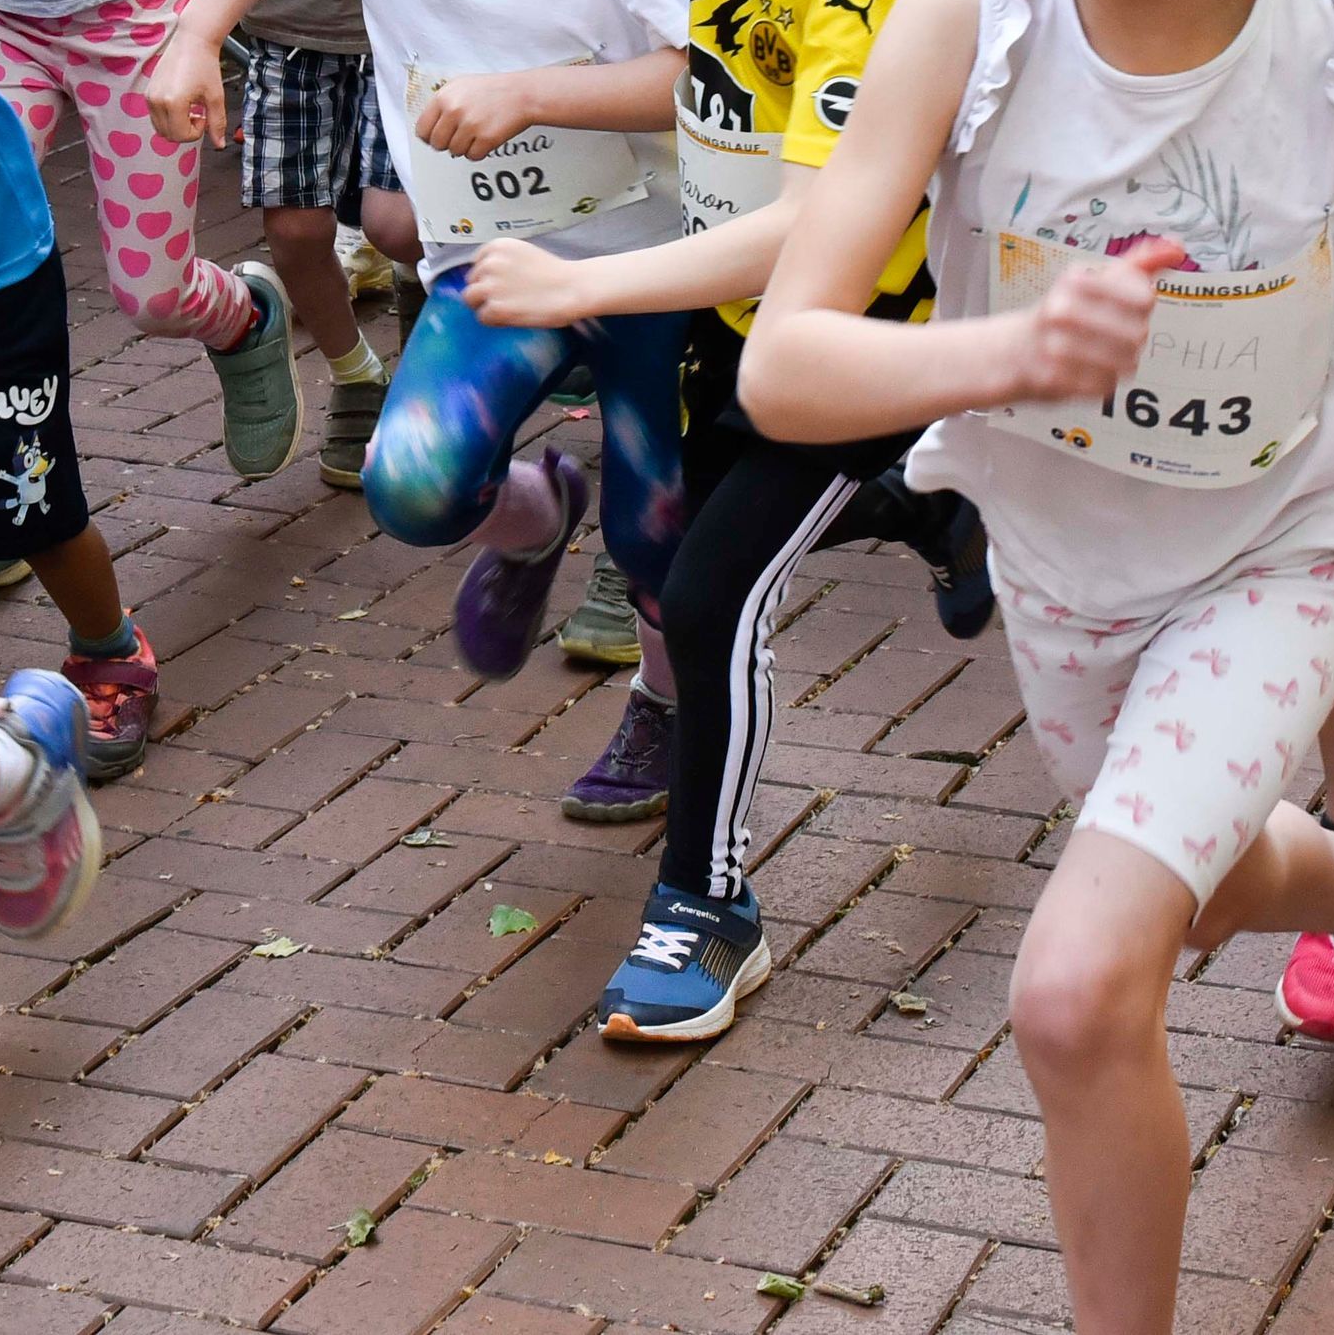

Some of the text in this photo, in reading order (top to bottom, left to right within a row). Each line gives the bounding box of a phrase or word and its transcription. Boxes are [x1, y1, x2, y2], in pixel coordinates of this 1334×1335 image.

[754, 27, 793, 70] BVB
[471, 166, 551, 202] 602
[679, 156, 741, 215] Jaron
[1156, 274, 1290, 297] ÜHLINGSLAUF
[1151, 332, 1262, 372] PHIA
[1102, 387, 1253, 437] 1643
[678, 905, 721, 924] energetics
